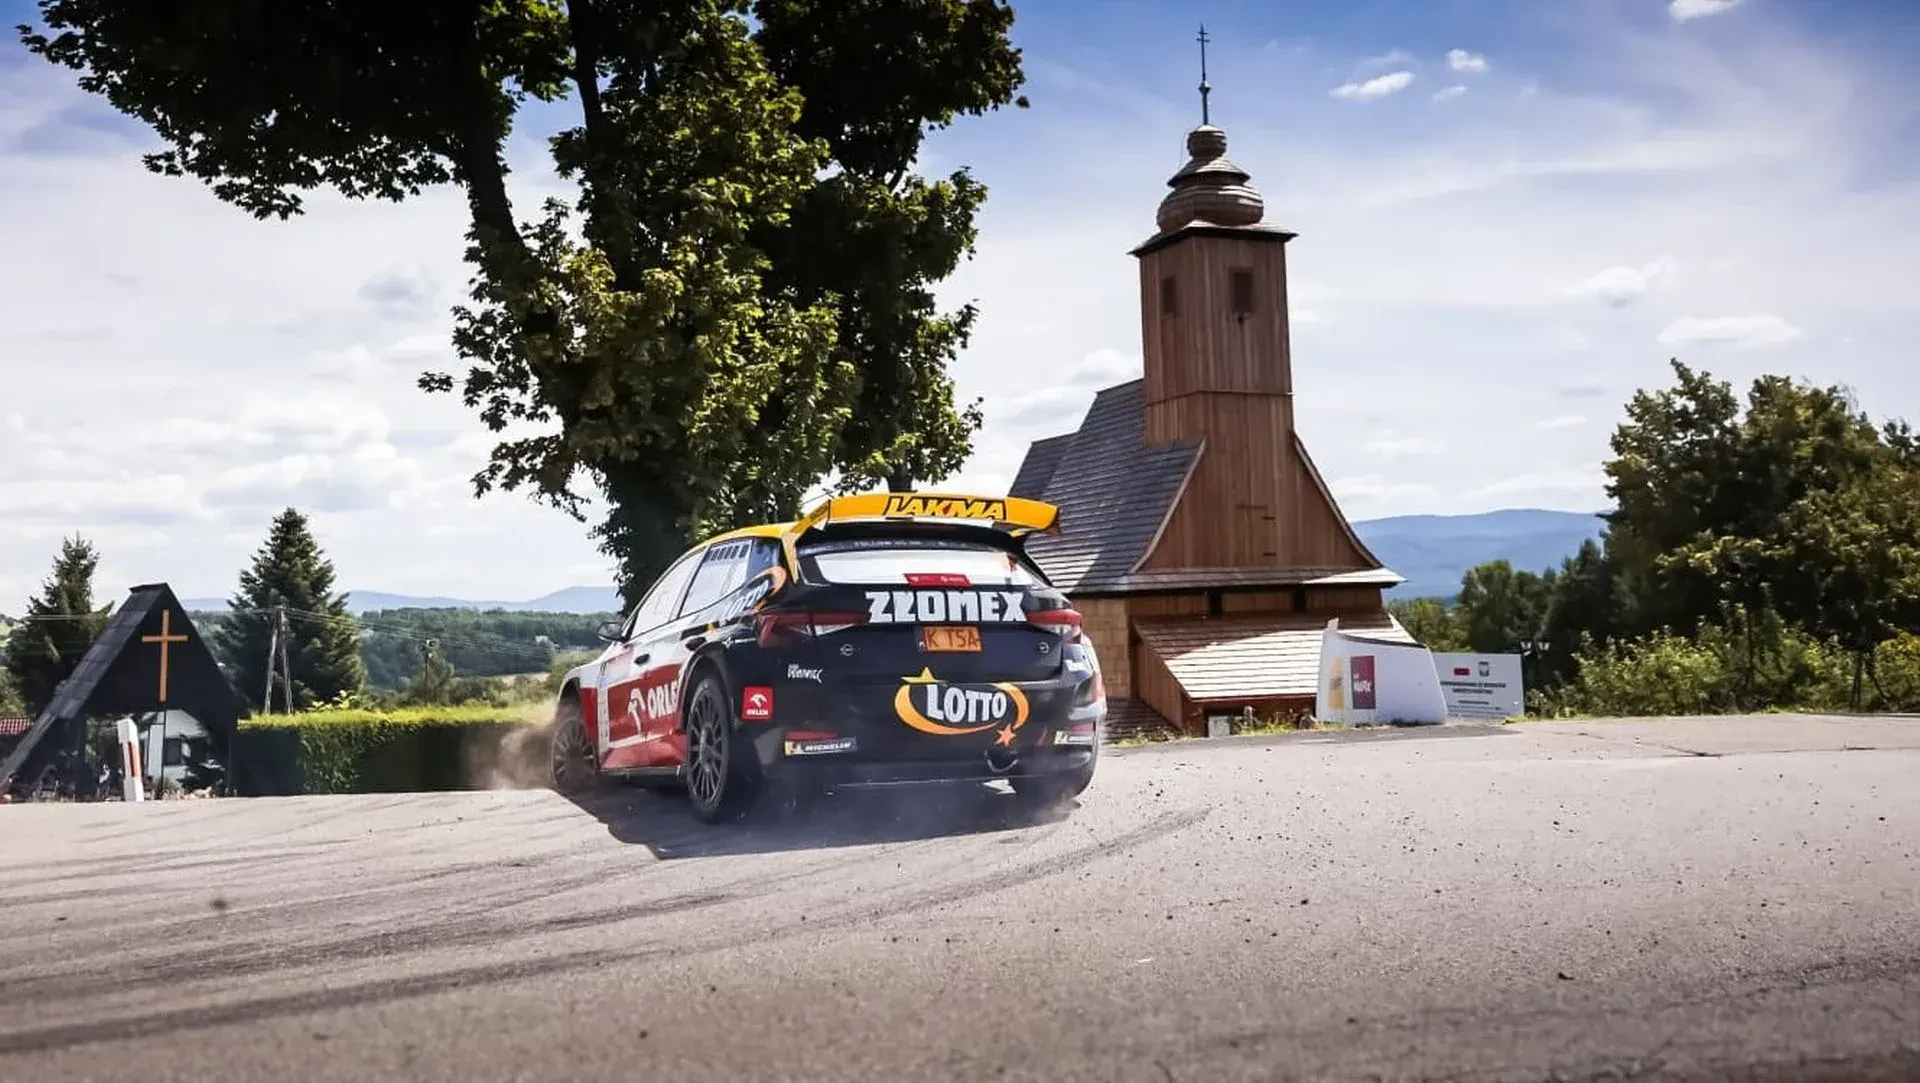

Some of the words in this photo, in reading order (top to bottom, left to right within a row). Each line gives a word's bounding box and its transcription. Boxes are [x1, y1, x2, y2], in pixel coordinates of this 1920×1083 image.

[884, 497, 1006, 520] LAKMA
[647, 681, 678, 719] ORLE
[926, 684, 1007, 722] LOTTO
